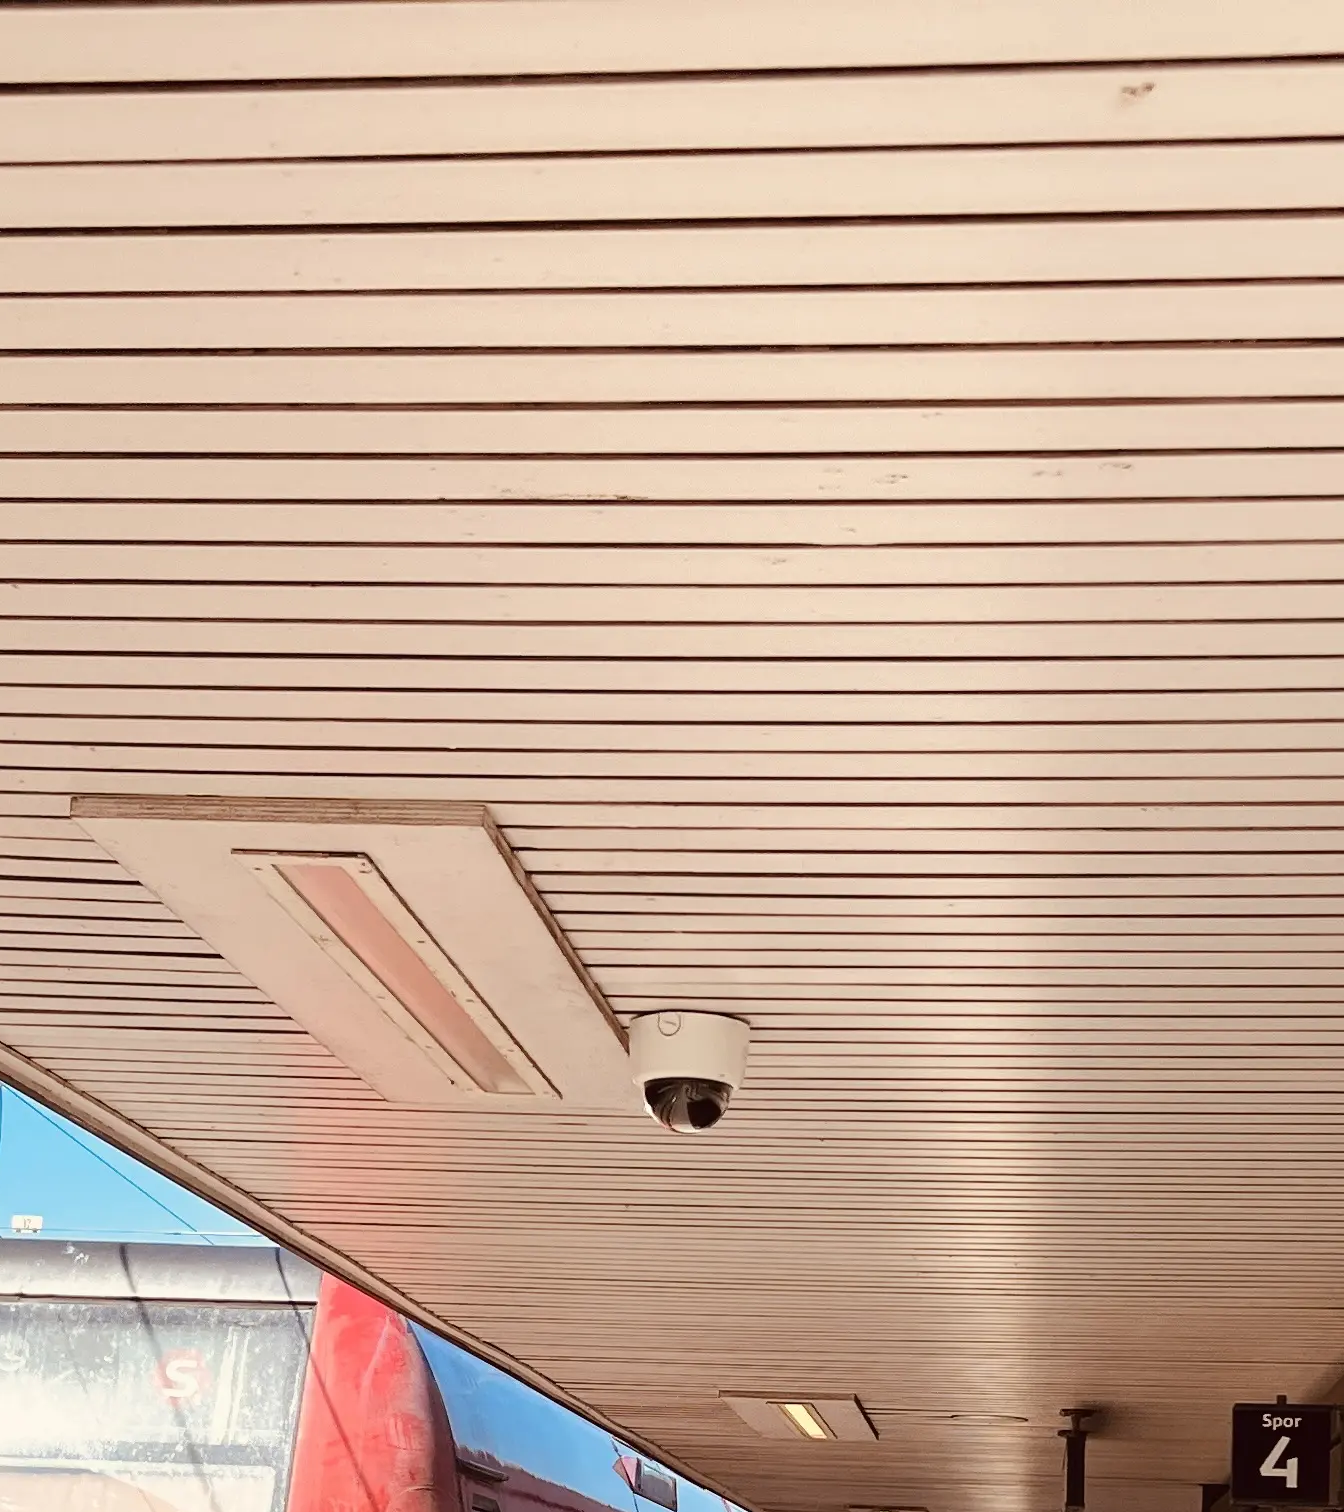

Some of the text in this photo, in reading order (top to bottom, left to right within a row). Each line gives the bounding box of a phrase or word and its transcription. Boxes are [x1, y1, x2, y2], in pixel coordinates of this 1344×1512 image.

[161, 1358, 200, 1398] S
[1262, 1413, 1303, 1431] Spor
[1259, 1435, 1299, 1489] 4
